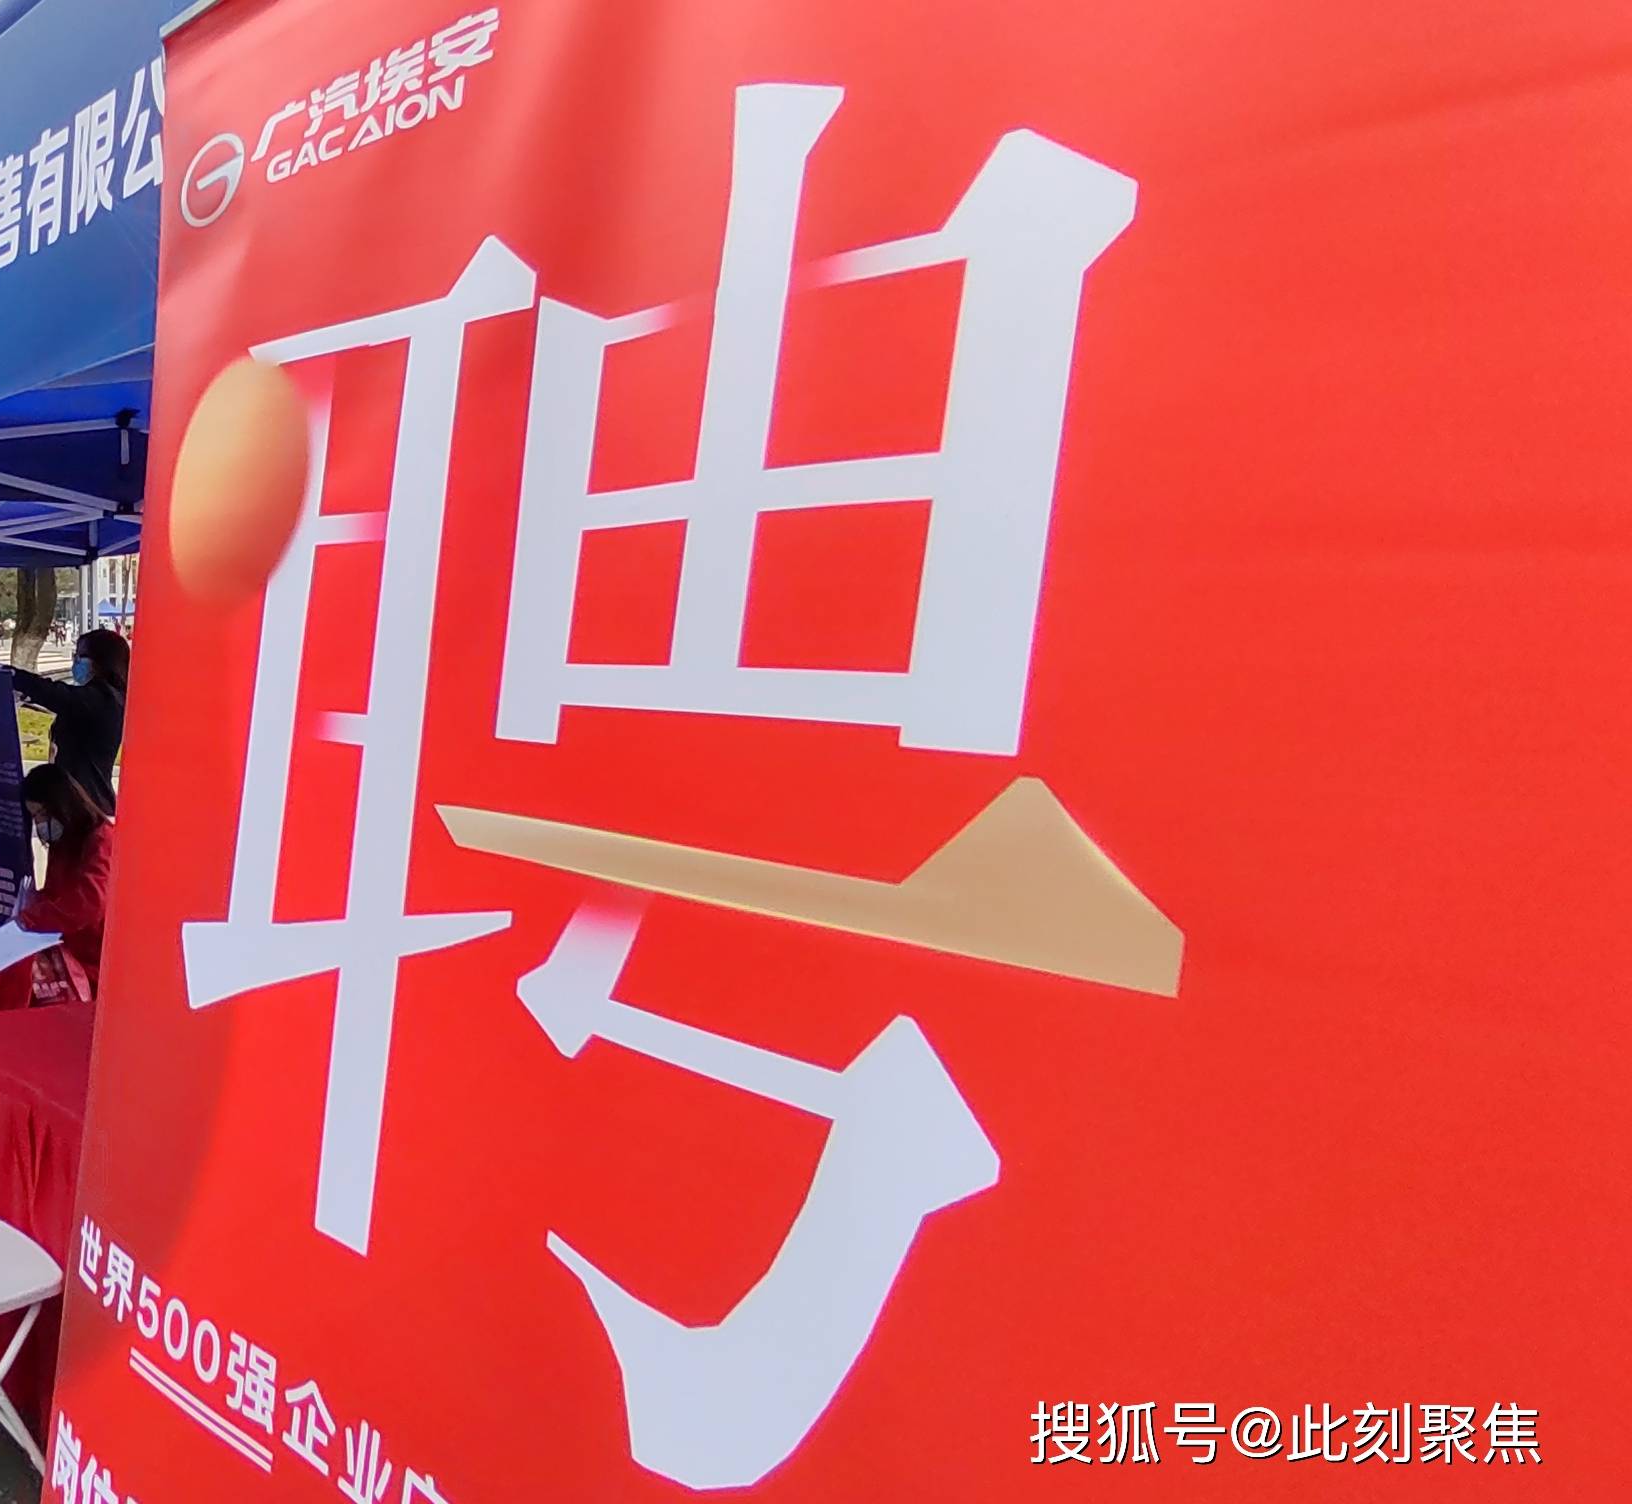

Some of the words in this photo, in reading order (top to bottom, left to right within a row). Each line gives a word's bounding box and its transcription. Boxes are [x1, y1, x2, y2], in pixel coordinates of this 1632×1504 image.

[251, 7, 499, 161] 广汽埃安
[266, 129, 343, 184] GAC
[348, 76, 465, 153] AION
[180, 84, 1184, 1490] 聘
